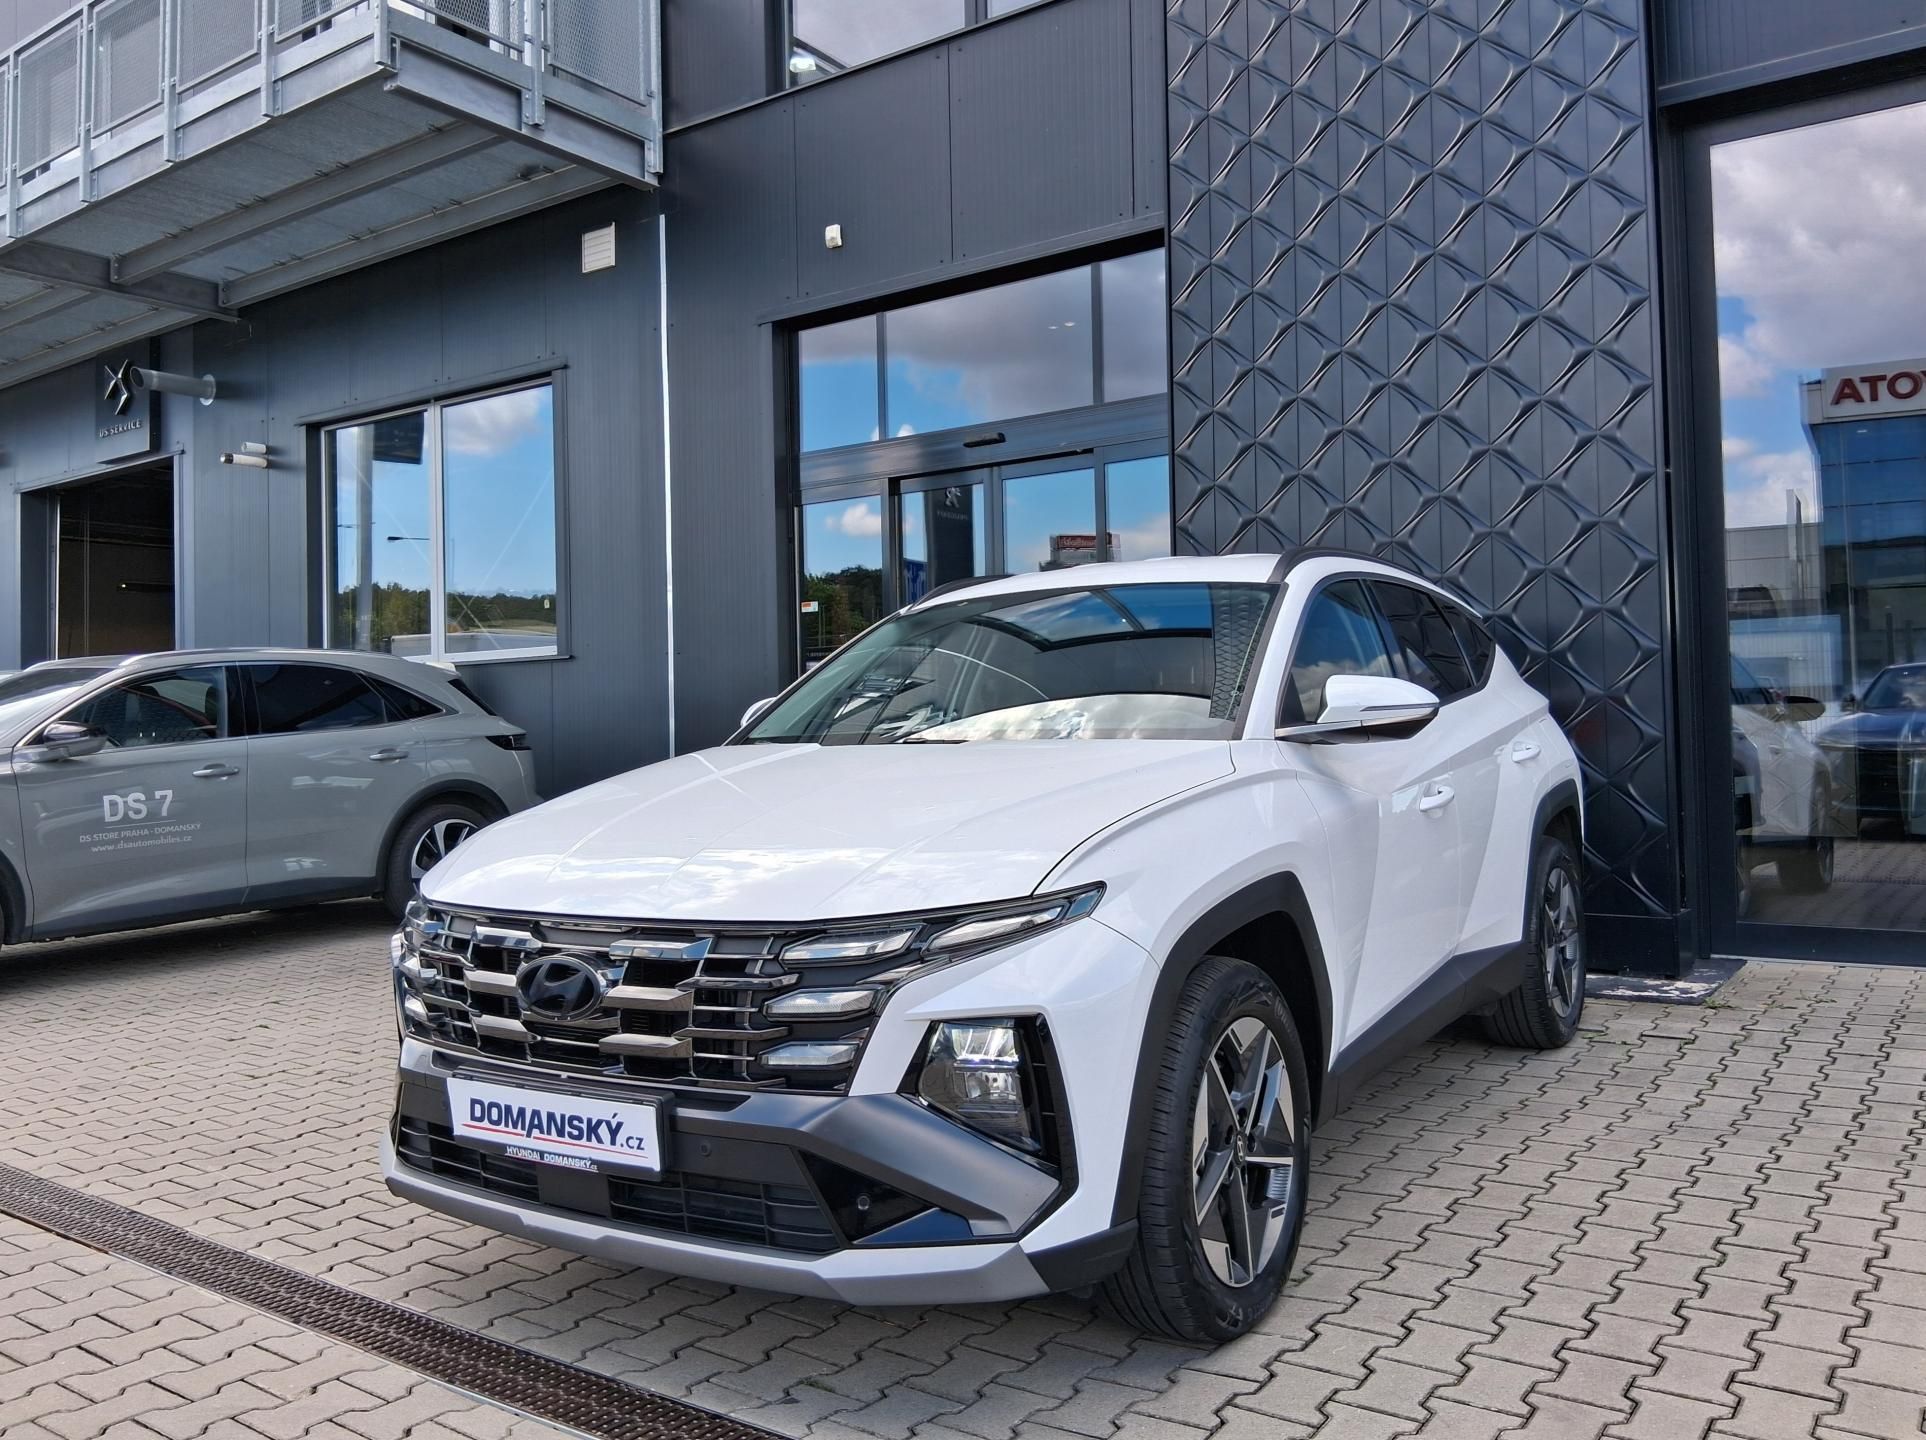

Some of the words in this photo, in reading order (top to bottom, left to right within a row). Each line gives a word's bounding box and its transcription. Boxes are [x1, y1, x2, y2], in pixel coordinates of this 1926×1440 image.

[110, 419, 141, 435] SERVICE
[102, 792, 148, 822] DS
[154, 789, 174, 817] 7
[79, 834, 92, 843] DS
[93, 831, 120, 841] STORE
[121, 827, 150, 838] PRAHA
[90, 834, 193, 853] www.dsautomobiles.cz
[506, 1145, 541, 1160] HYUNDAI
